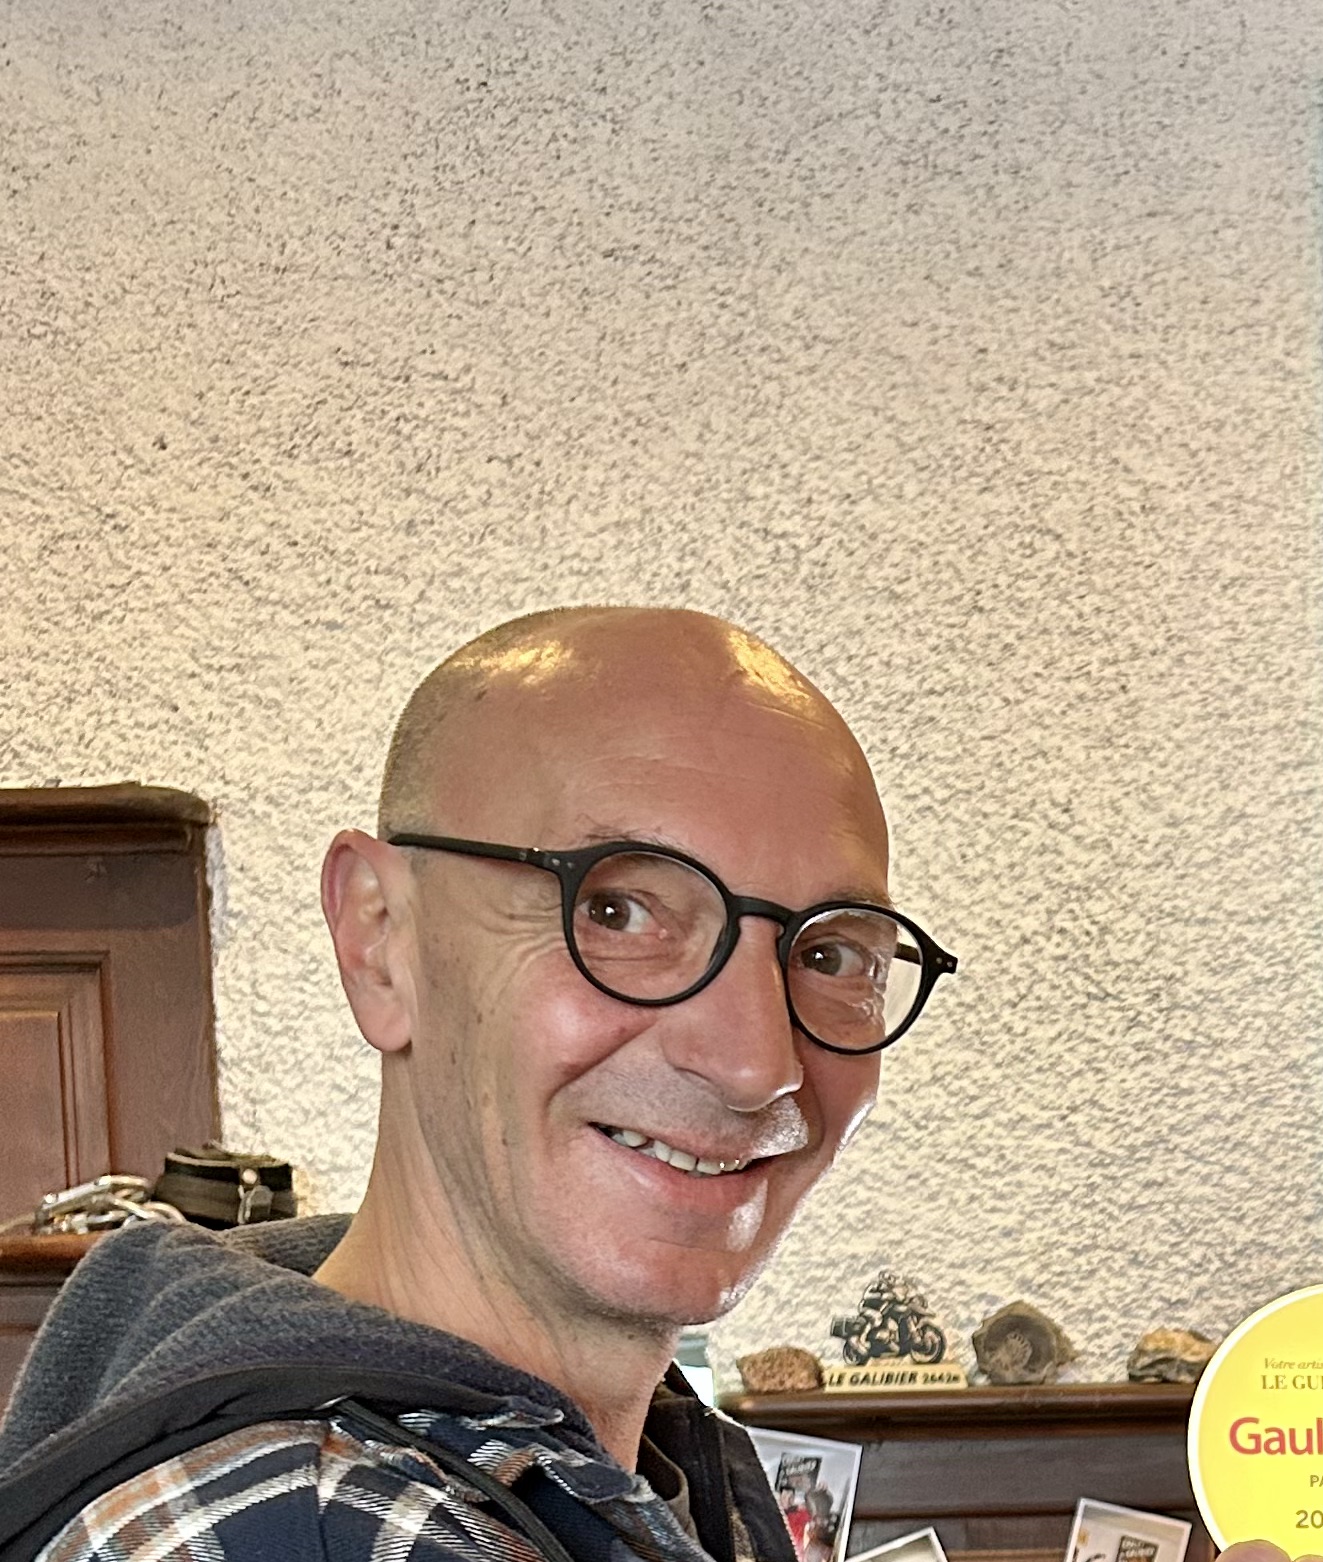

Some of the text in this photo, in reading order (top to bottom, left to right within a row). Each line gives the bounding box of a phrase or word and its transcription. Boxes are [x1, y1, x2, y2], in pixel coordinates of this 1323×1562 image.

[1264, 1358, 1295, 1370] Votre
[829, 1372, 846, 1386] LE
[850, 1371, 918, 1386] GALIBIER
[1261, 1375, 1287, 1390] LE
